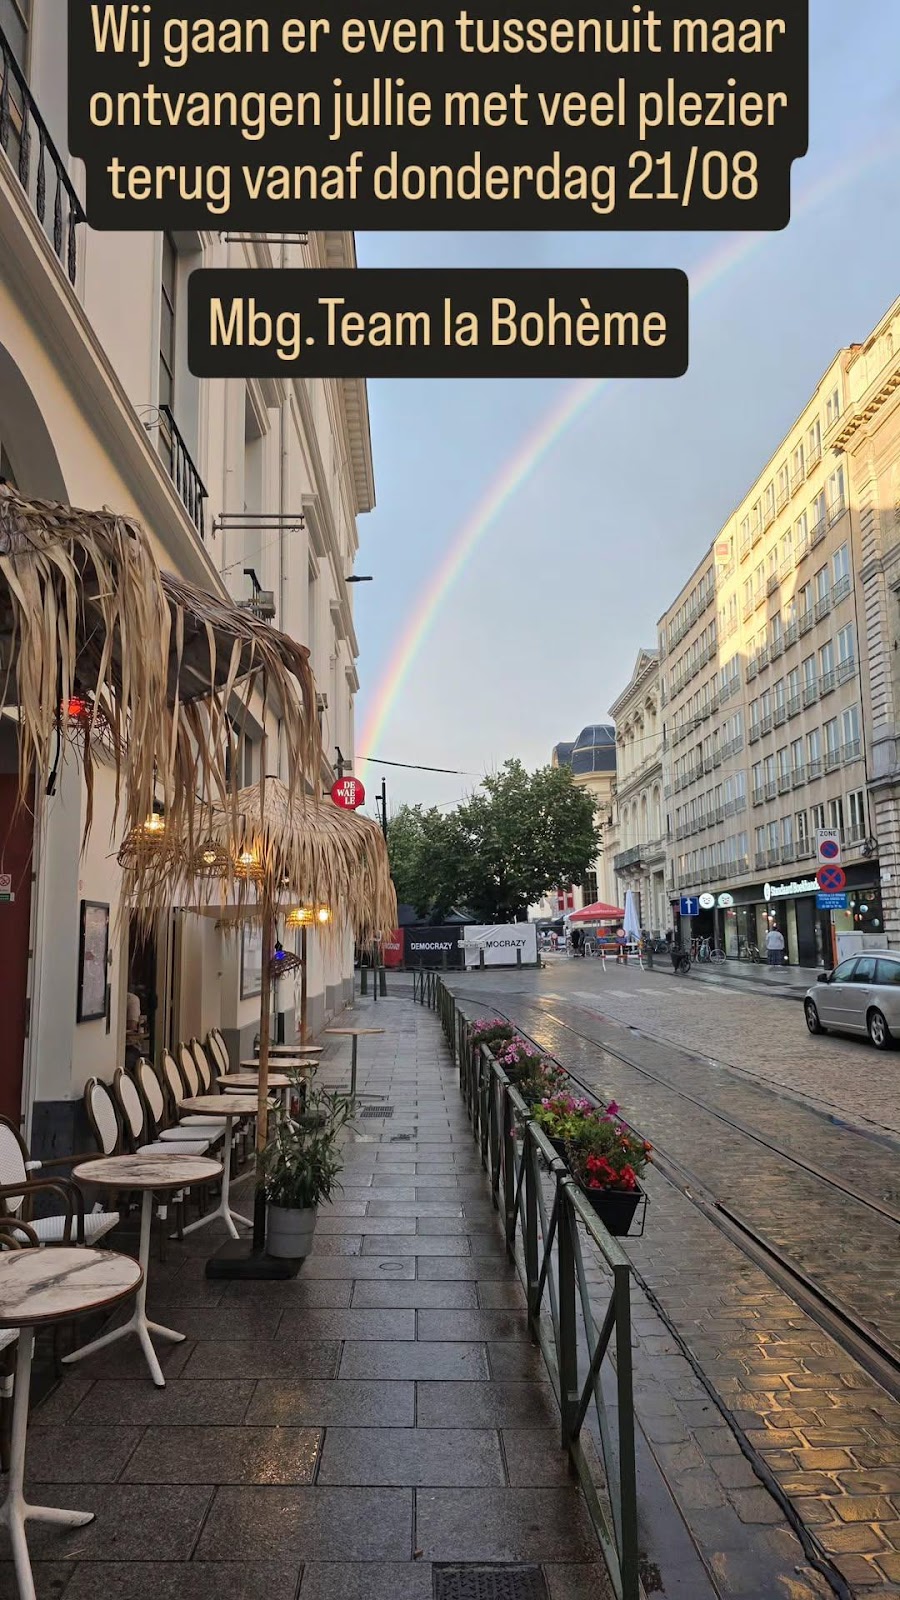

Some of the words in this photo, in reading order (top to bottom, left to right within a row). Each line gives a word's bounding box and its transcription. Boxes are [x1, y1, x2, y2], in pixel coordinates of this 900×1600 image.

[343, 781, 355, 789] DE
[337, 789, 355, 797] WAE
[345, 797, 355, 805] LE
[410, 942, 453, 951] DEMOCRAZY
